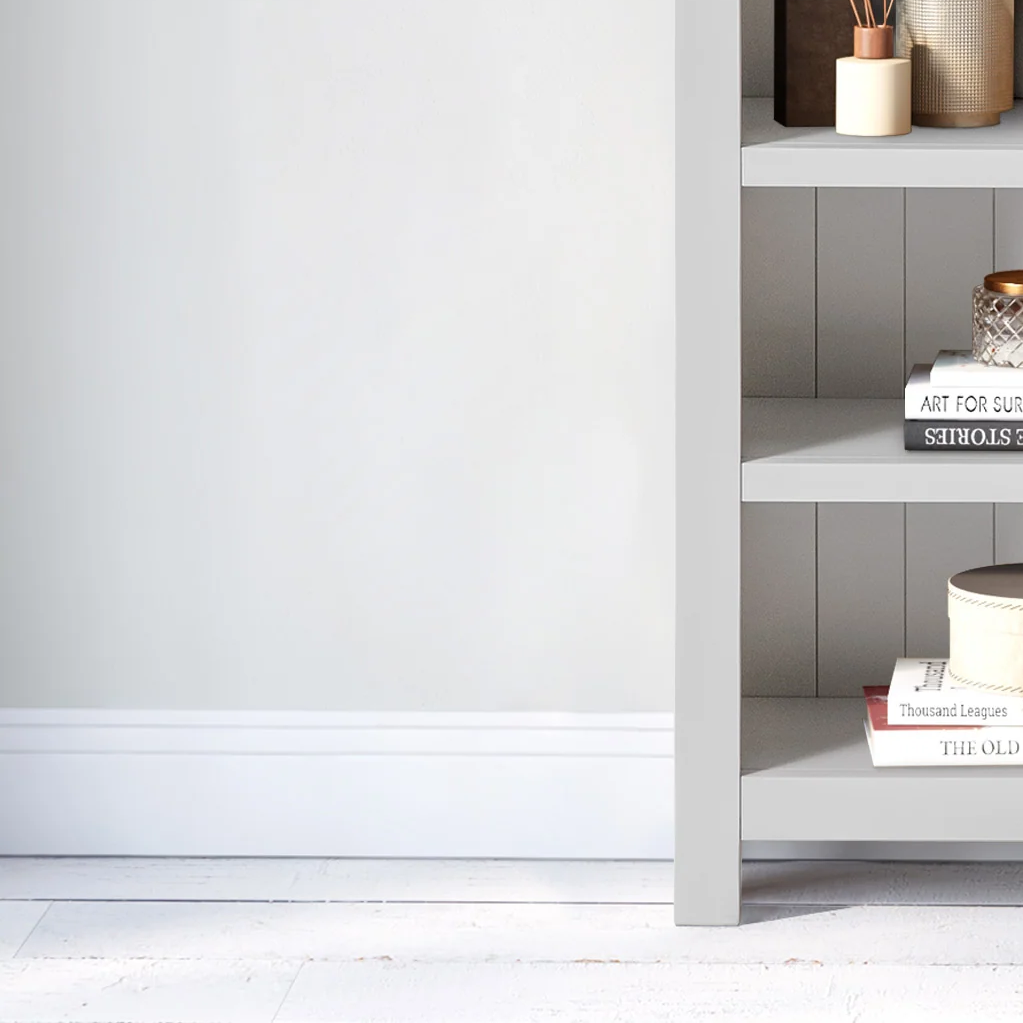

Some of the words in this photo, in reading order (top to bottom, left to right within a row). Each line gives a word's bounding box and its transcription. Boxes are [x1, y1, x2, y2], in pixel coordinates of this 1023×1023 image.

[920, 395, 949, 413] ART
[956, 395, 987, 413] FOR
[925, 427, 1011, 445] STORIES
[900, 703, 957, 717] Thousand
[960, 704, 1008, 720] Leagues
[940, 740, 977, 756] THE
[981, 739, 1020, 755] OLD
